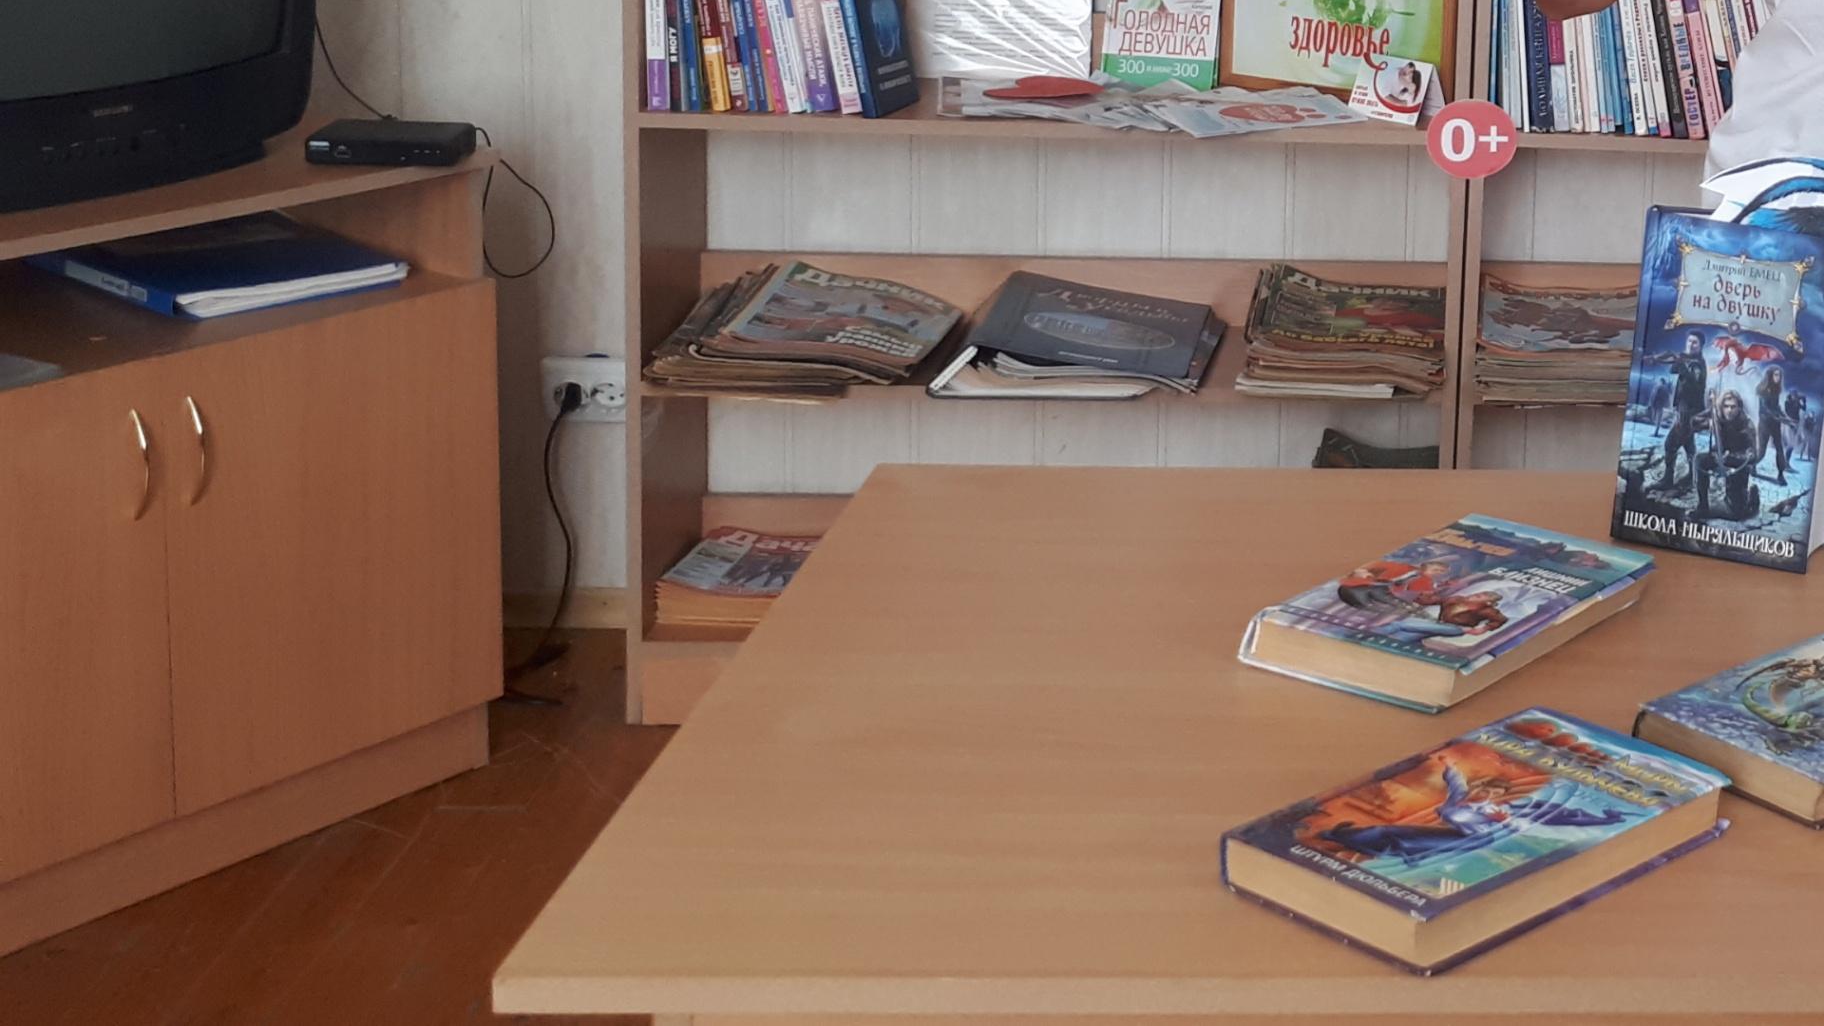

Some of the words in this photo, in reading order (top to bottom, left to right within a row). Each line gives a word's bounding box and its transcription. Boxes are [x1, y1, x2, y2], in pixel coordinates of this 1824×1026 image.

[1118, 31, 1207, 58] ДЕВУШКА
[1289, 15, 1391, 67] здоровье
[1673, 22, 1692, 71] ВРЕДНЫЕ
[1118, 58, 1145, 75] 300
[1172, 61, 1200, 78] 300
[1440, 118, 1509, 162] 0+
[1293, 272, 1430, 298] Дачник
[1702, 259, 1747, 276] Дмитрий
[1749, 268, 1781, 282] ЕМЕЦ
[796, 268, 945, 311] Дачник
[1692, 294, 1711, 311] на
[1716, 292, 1781, 324] двушку
[1623, 509, 1677, 535] ШКОЛА
[1683, 519, 1795, 559] НЫРЯЛЬЩИКОВ
[1488, 566, 1580, 595] БЛИЗНЕЦ
[1290, 844, 1347, 873] ШТУРМ
[1342, 867, 1427, 907] ДЮЛЬБЕРА
